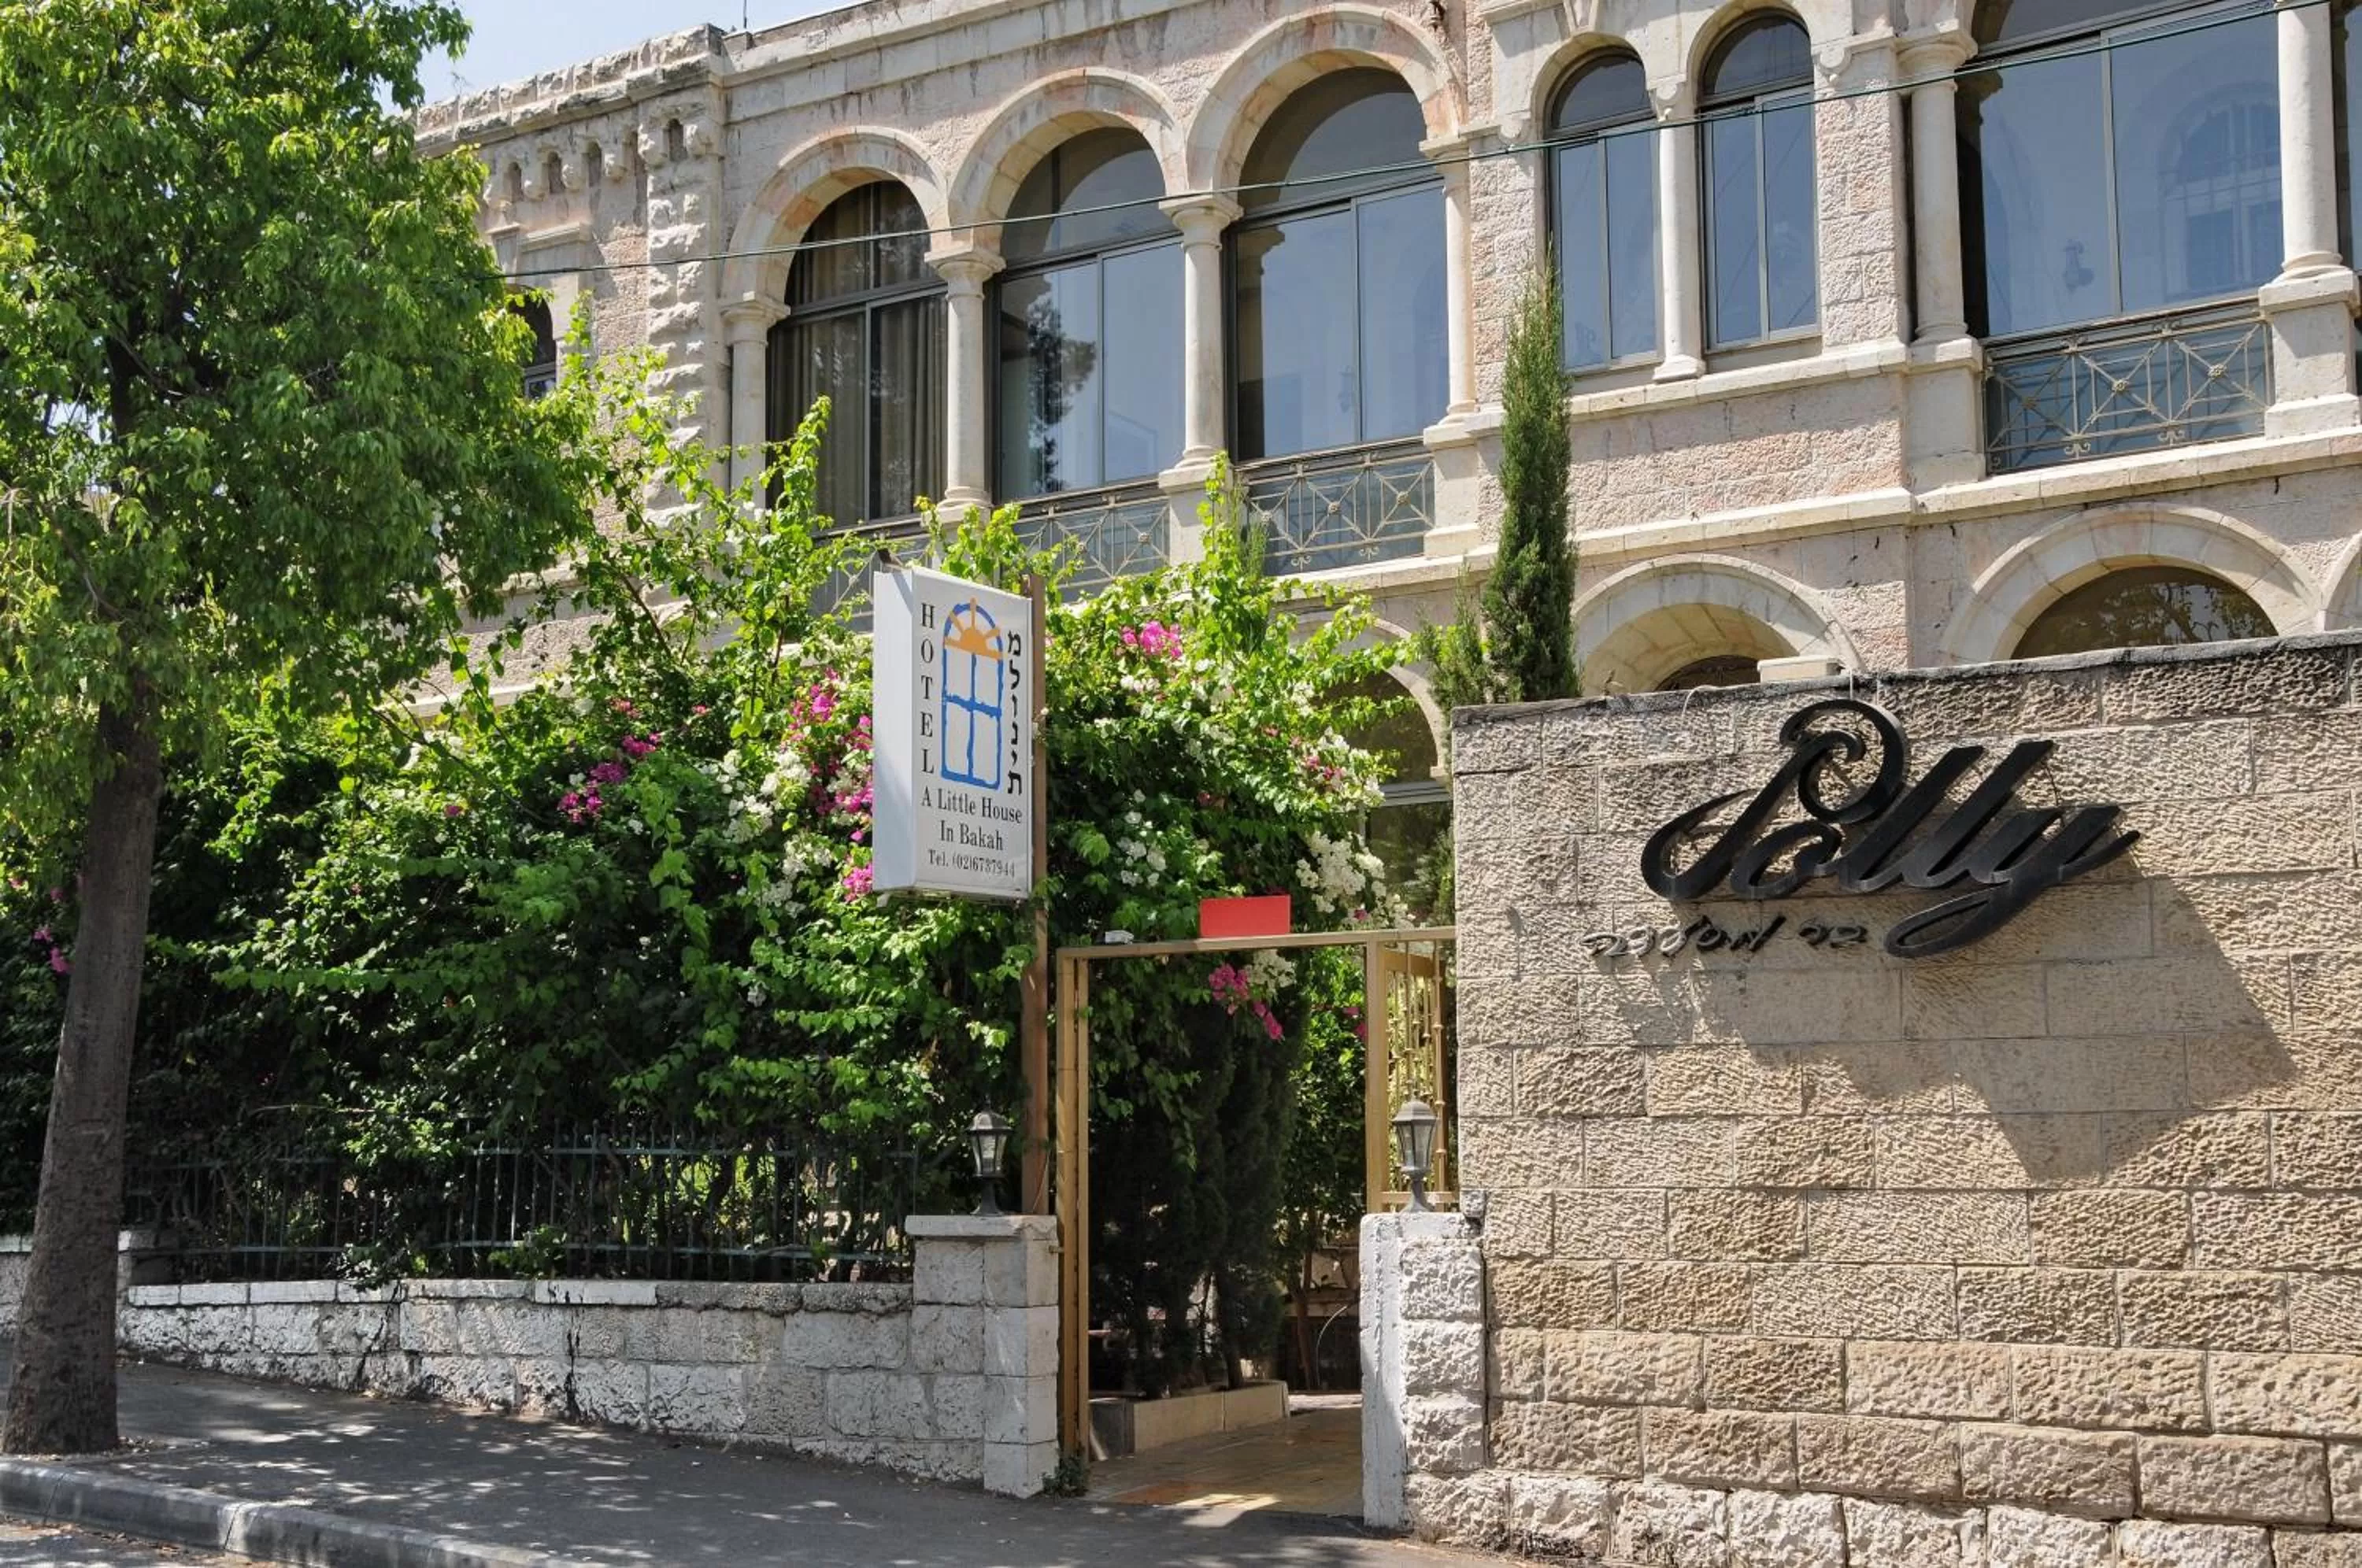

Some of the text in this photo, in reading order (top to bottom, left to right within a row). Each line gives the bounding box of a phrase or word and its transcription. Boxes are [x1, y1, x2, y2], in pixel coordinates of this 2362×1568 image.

[920, 603, 935, 775] HOTEL
[1007, 631, 1022, 797] מלונית
[921, 786, 1023, 824] A Little House
[940, 820, 1004, 851] In Bakah
[928, 849, 950, 867] Tel.
